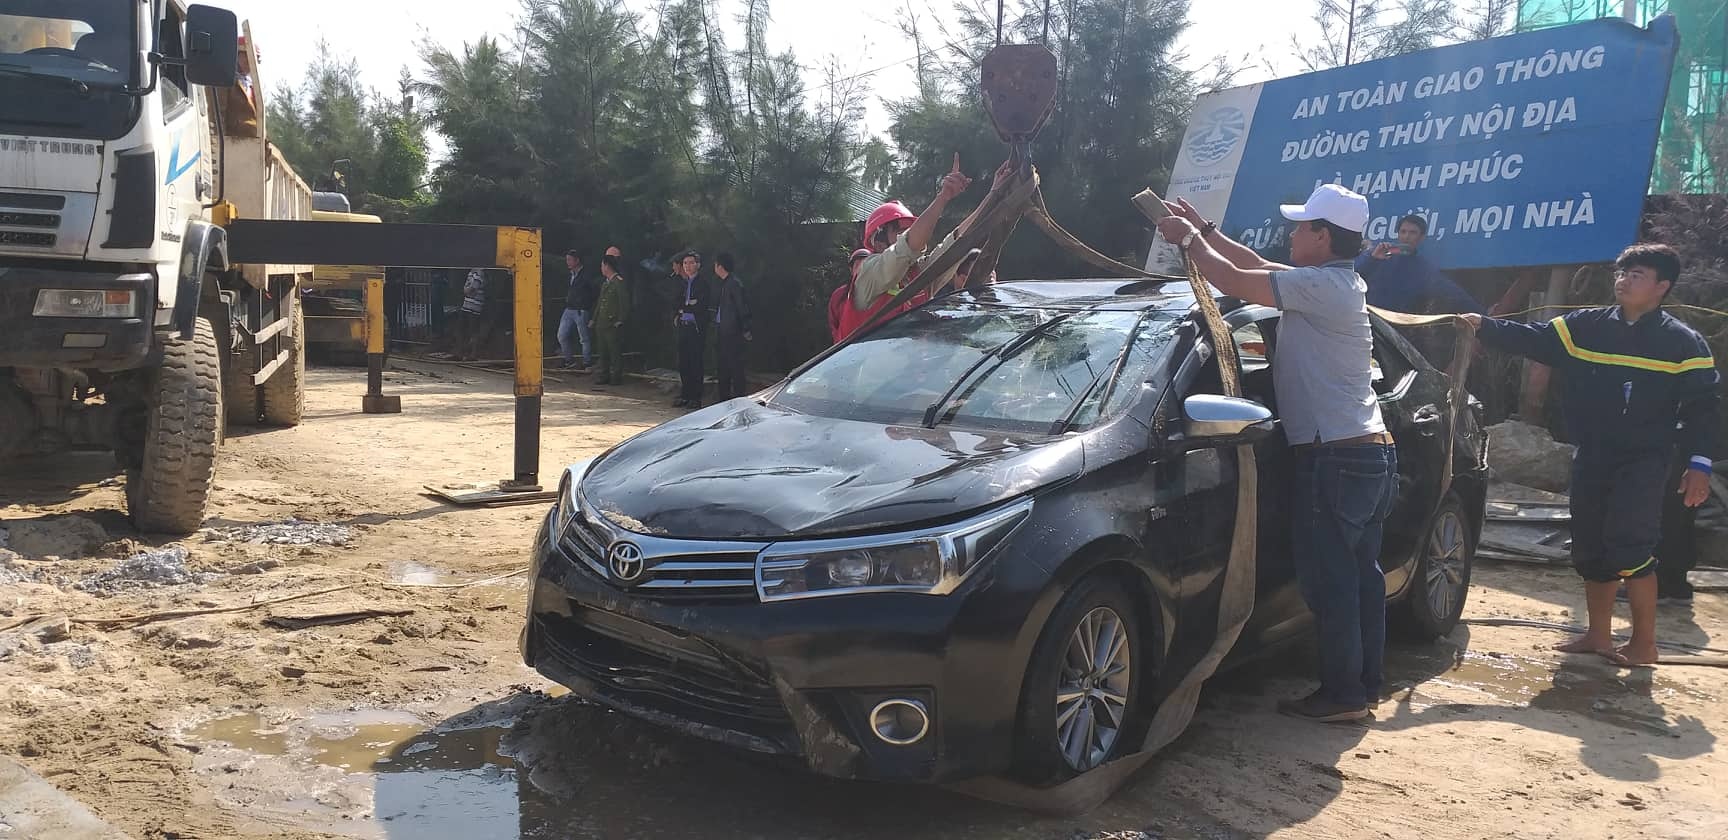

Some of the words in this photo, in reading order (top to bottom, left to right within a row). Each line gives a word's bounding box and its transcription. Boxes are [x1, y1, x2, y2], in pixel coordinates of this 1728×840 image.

[1292, 95, 1330, 120] AN
[1337, 80, 1407, 113] TOÀN
[1414, 66, 1484, 99] GIAO
[1496, 45, 1605, 85] THÔNG
[1281, 130, 1370, 162] ĐƯỜNG
[1378, 111, 1455, 148] THỦY
[1459, 103, 1515, 139] NỘI
[1522, 97, 1577, 131] ĐỊA
[1352, 165, 1432, 198] HẠNH
[1438, 150, 1524, 187] PHÚC
[1240, 218, 1285, 249] CỦA
[1454, 205, 1515, 238] MỌI
[1522, 192, 1595, 229] NHÀ
